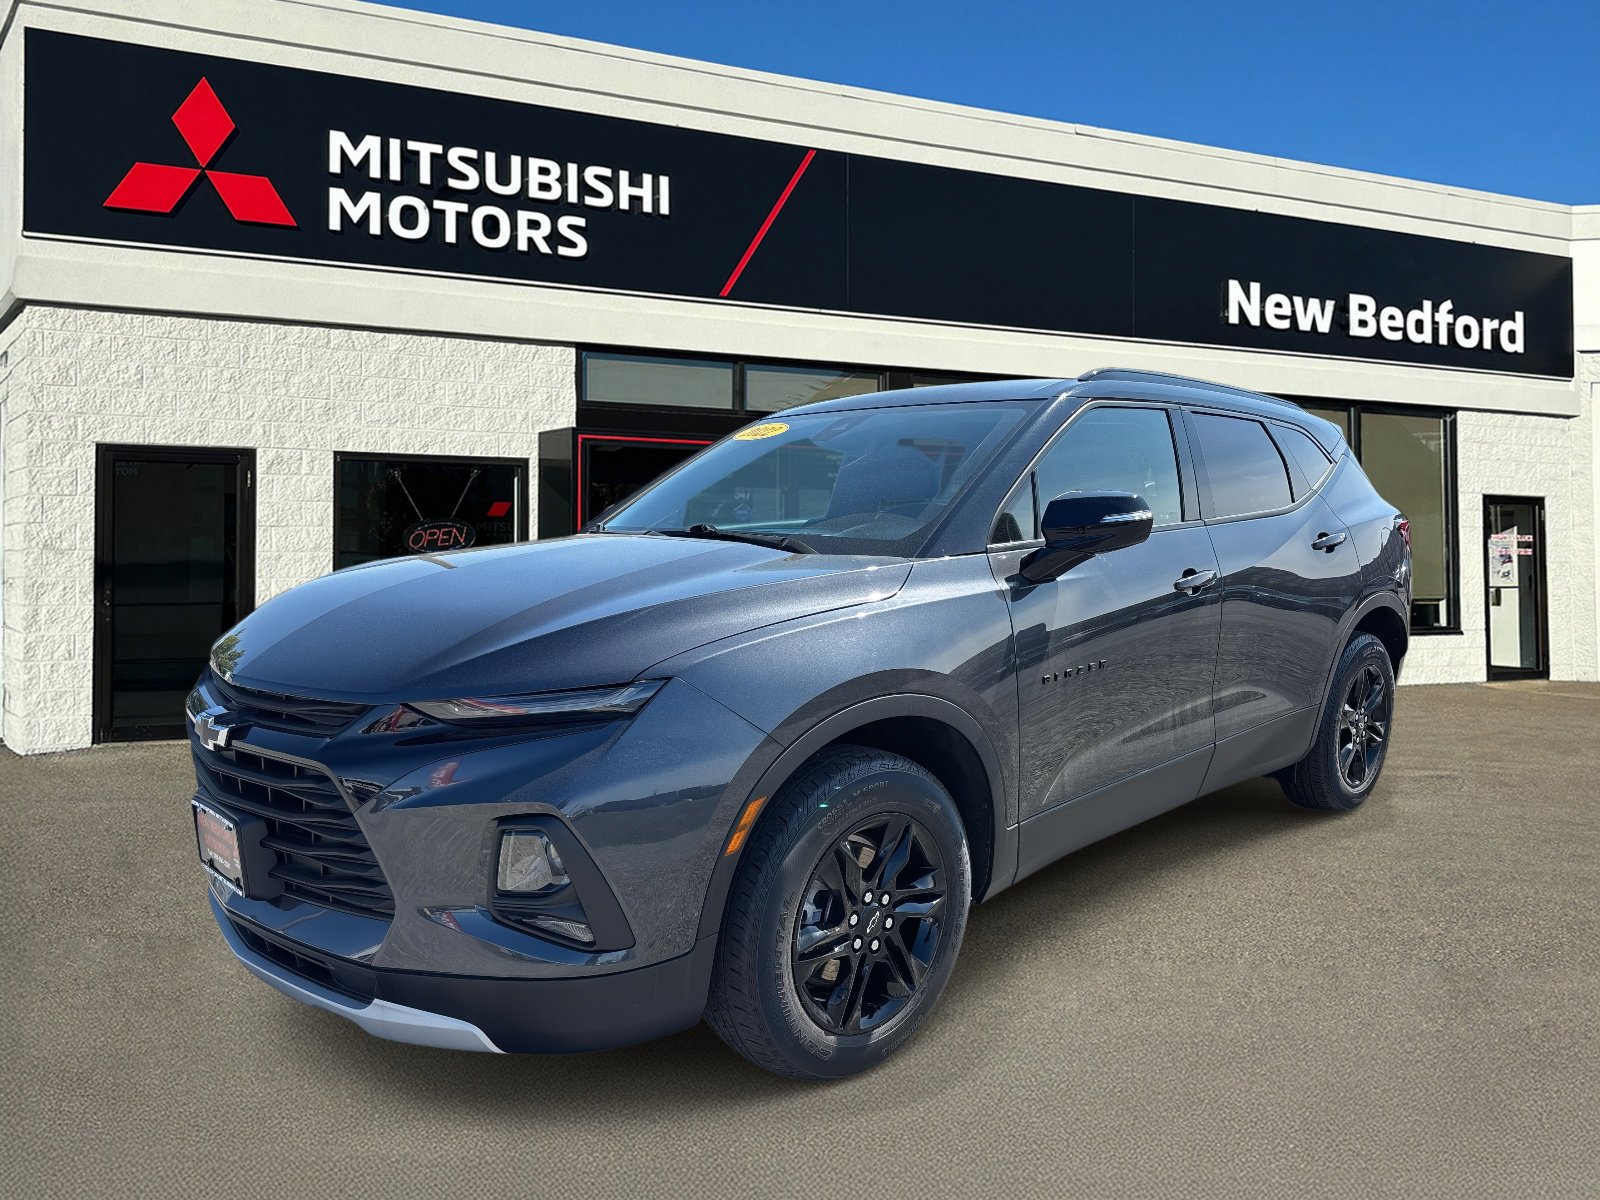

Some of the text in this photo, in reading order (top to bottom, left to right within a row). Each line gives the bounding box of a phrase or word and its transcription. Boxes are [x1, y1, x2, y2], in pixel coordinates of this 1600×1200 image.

[328, 129, 670, 215] MITSUBISHI
[328, 187, 588, 258] MOTORS
[1227, 279, 1525, 353] New Bedford
[408, 526, 467, 549] OPEN
